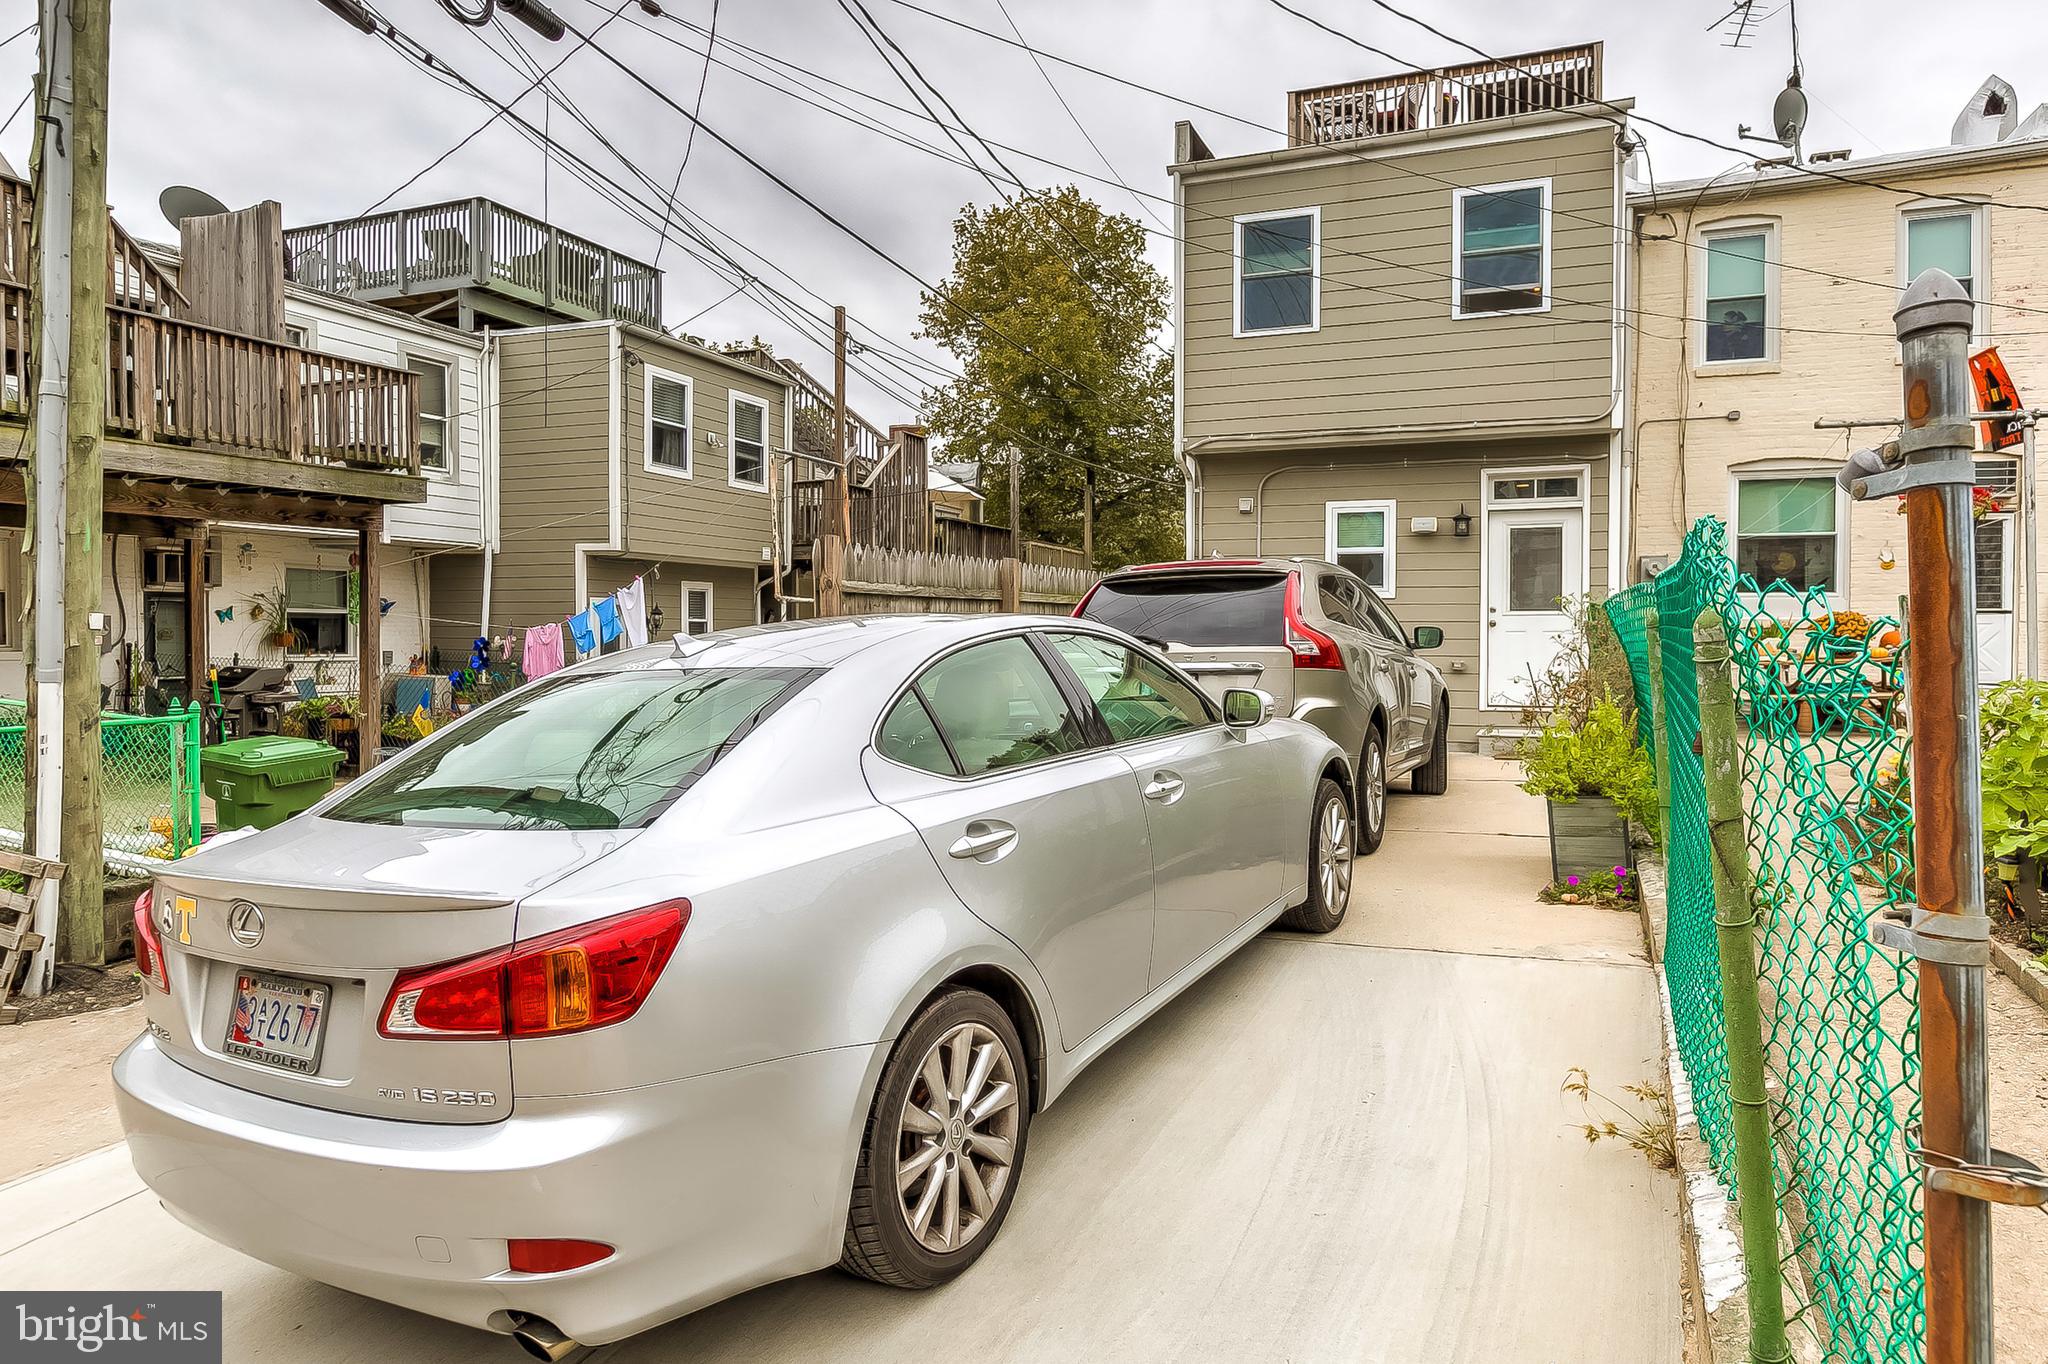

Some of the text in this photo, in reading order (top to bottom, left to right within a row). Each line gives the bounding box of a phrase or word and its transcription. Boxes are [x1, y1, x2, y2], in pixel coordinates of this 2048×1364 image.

[260, 982, 303, 996] MARYLAND
[226, 1043, 310, 1072] LEN STOLER
[441, 1089, 497, 1107] 250
